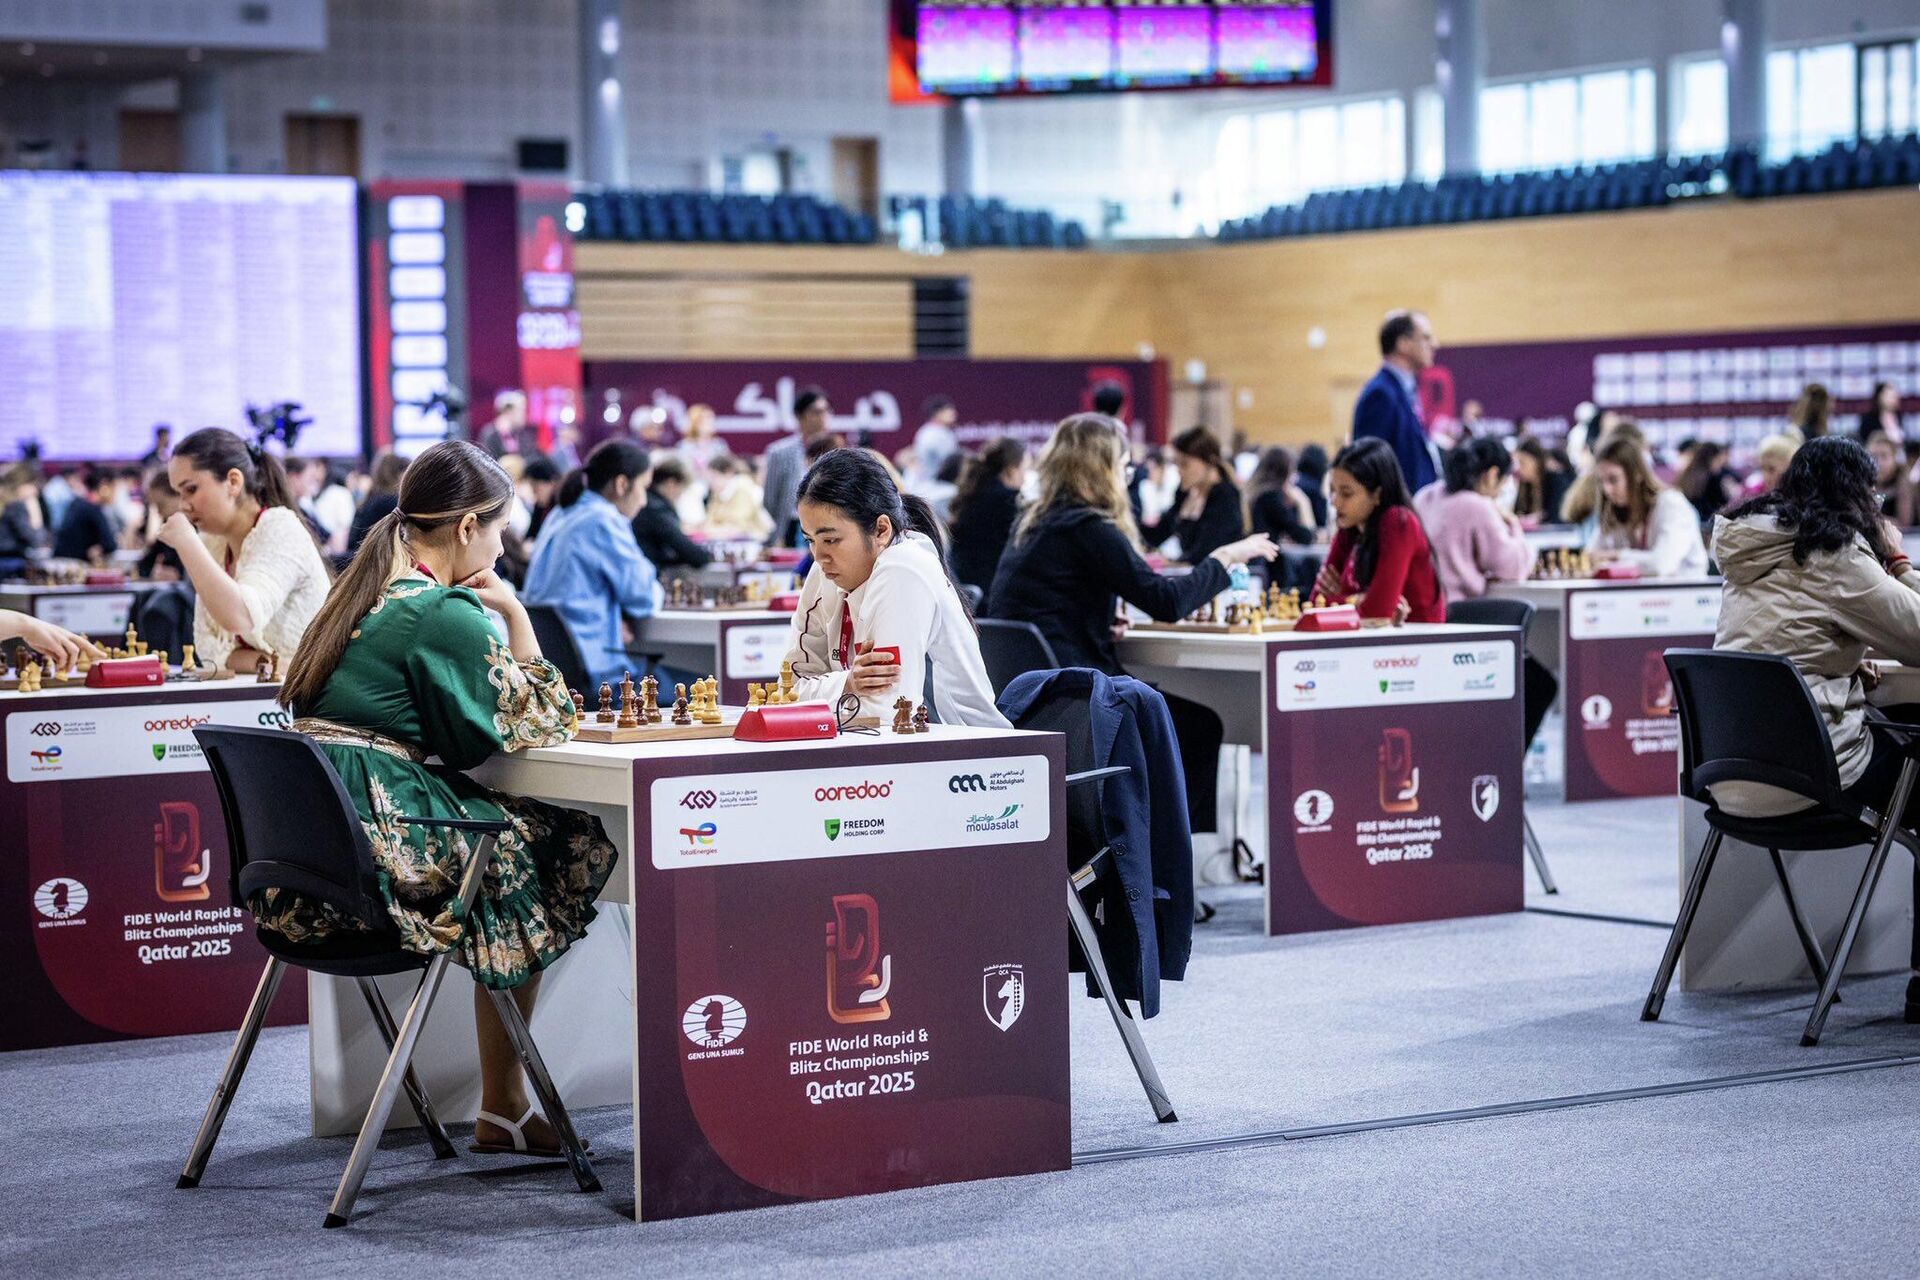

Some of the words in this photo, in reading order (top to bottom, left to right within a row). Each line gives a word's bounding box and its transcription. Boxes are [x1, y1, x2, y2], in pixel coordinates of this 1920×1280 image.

[815, 780, 891, 801] ooredoo
[844, 819, 885, 829] FREEDOM
[966, 819, 1019, 832] mowasalat
[680, 848, 718, 856] TotalEnergies
[1366, 847, 1403, 865] Qatar
[1403, 843, 1433, 860] 2025
[124, 913, 152, 926] FIDE
[154, 910, 192, 923] World
[195, 907, 230, 921] Rapid
[124, 929, 151, 941] Blitz
[153, 922, 244, 938] Championships
[138, 944, 190, 964] Qatar
[191, 939, 231, 957] 2025
[706, 1039, 724, 1048] FIDE
[789, 1040, 822, 1056] FIDE
[826, 1034, 869, 1052] World
[873, 1029, 915, 1048] Rapid
[918, 1028, 929, 1042] &
[687, 1052, 705, 1060] GENS
[706, 1050, 720, 1058] UNA
[721, 1048, 744, 1057] SUMUS
[789, 1060, 822, 1075] Blitz
[824, 1049, 930, 1070] Championships
[806, 1079, 866, 1104] Qatar
[869, 1071, 915, 1095] 2025
